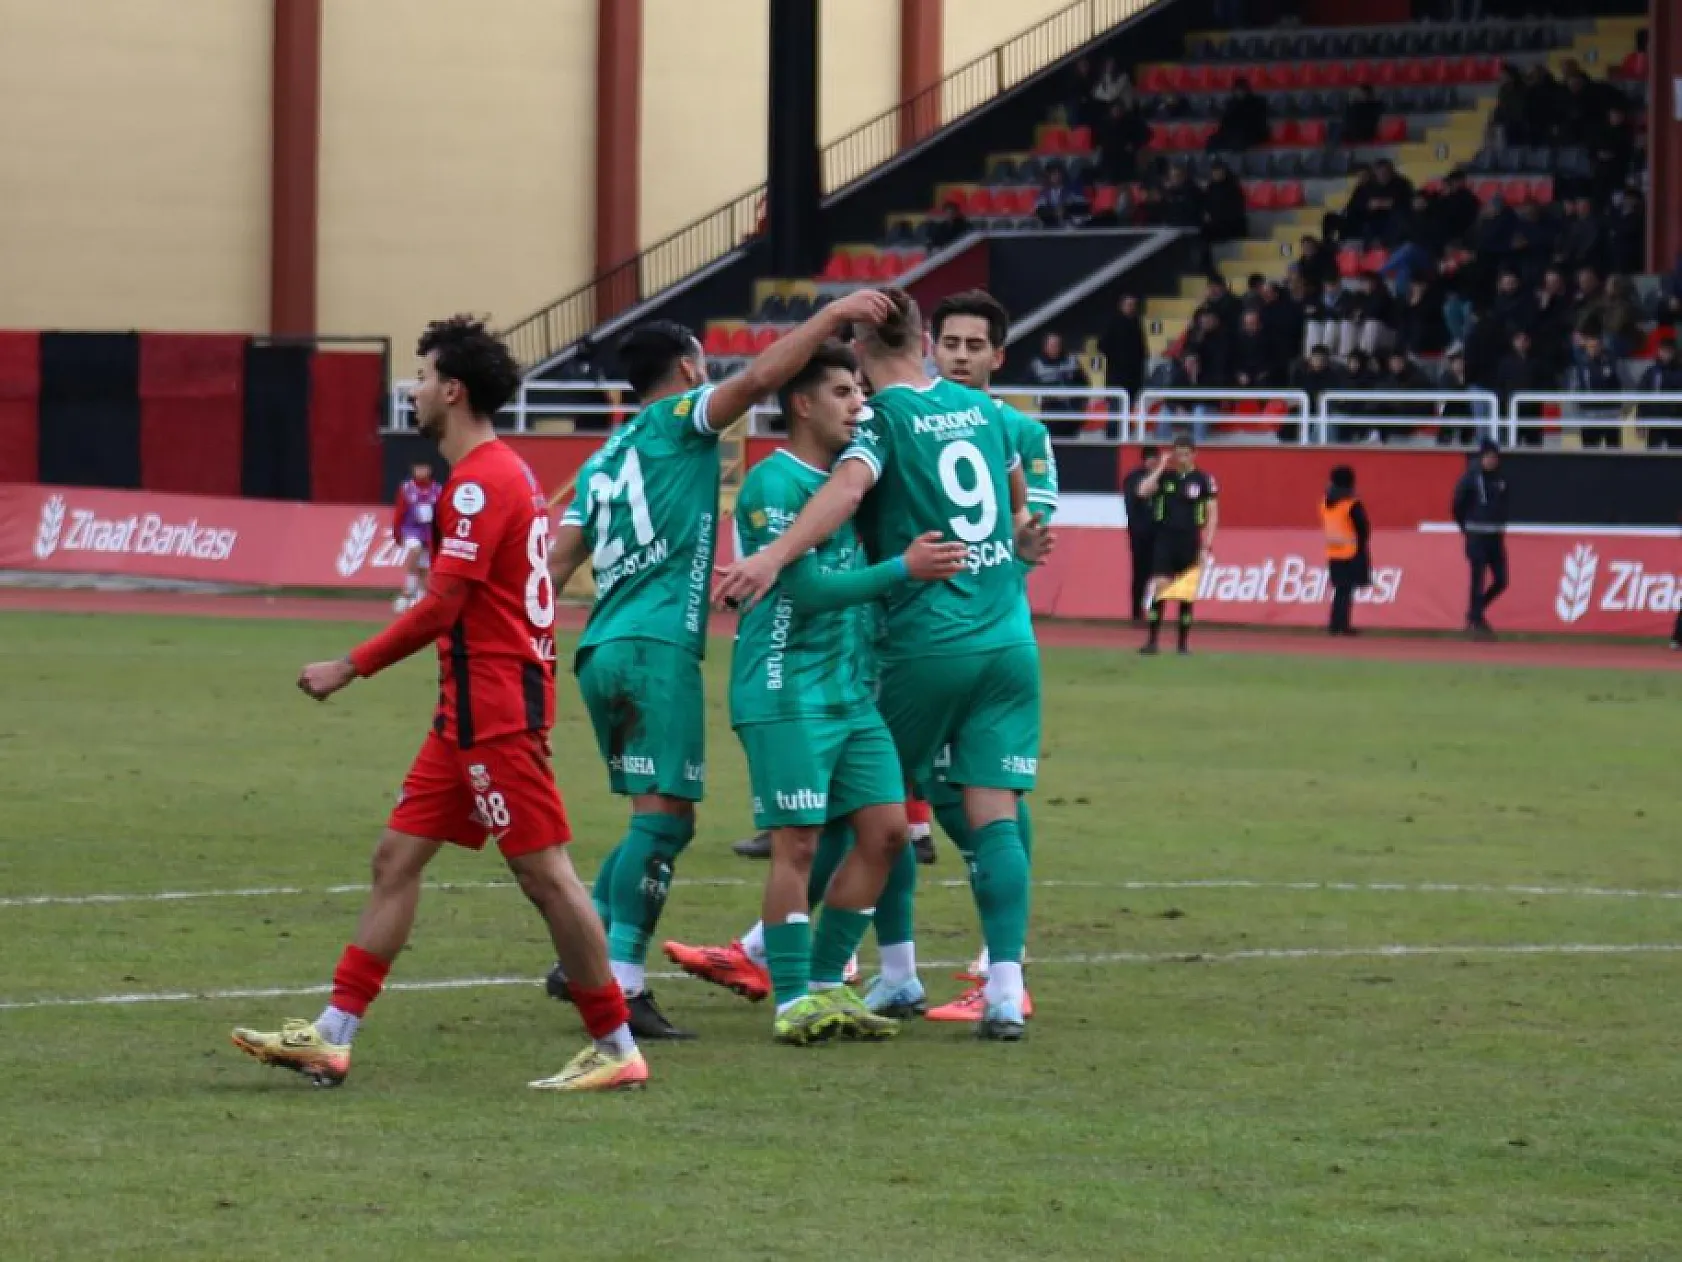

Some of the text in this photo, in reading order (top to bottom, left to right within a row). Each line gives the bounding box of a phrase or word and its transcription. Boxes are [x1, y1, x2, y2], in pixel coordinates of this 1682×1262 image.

[64, 509, 137, 552] Ziraat
[587, 446, 655, 569] 21
[938, 440, 997, 541] 9
[525, 516, 556, 627] 8
[1196, 553, 1275, 602] iraat
